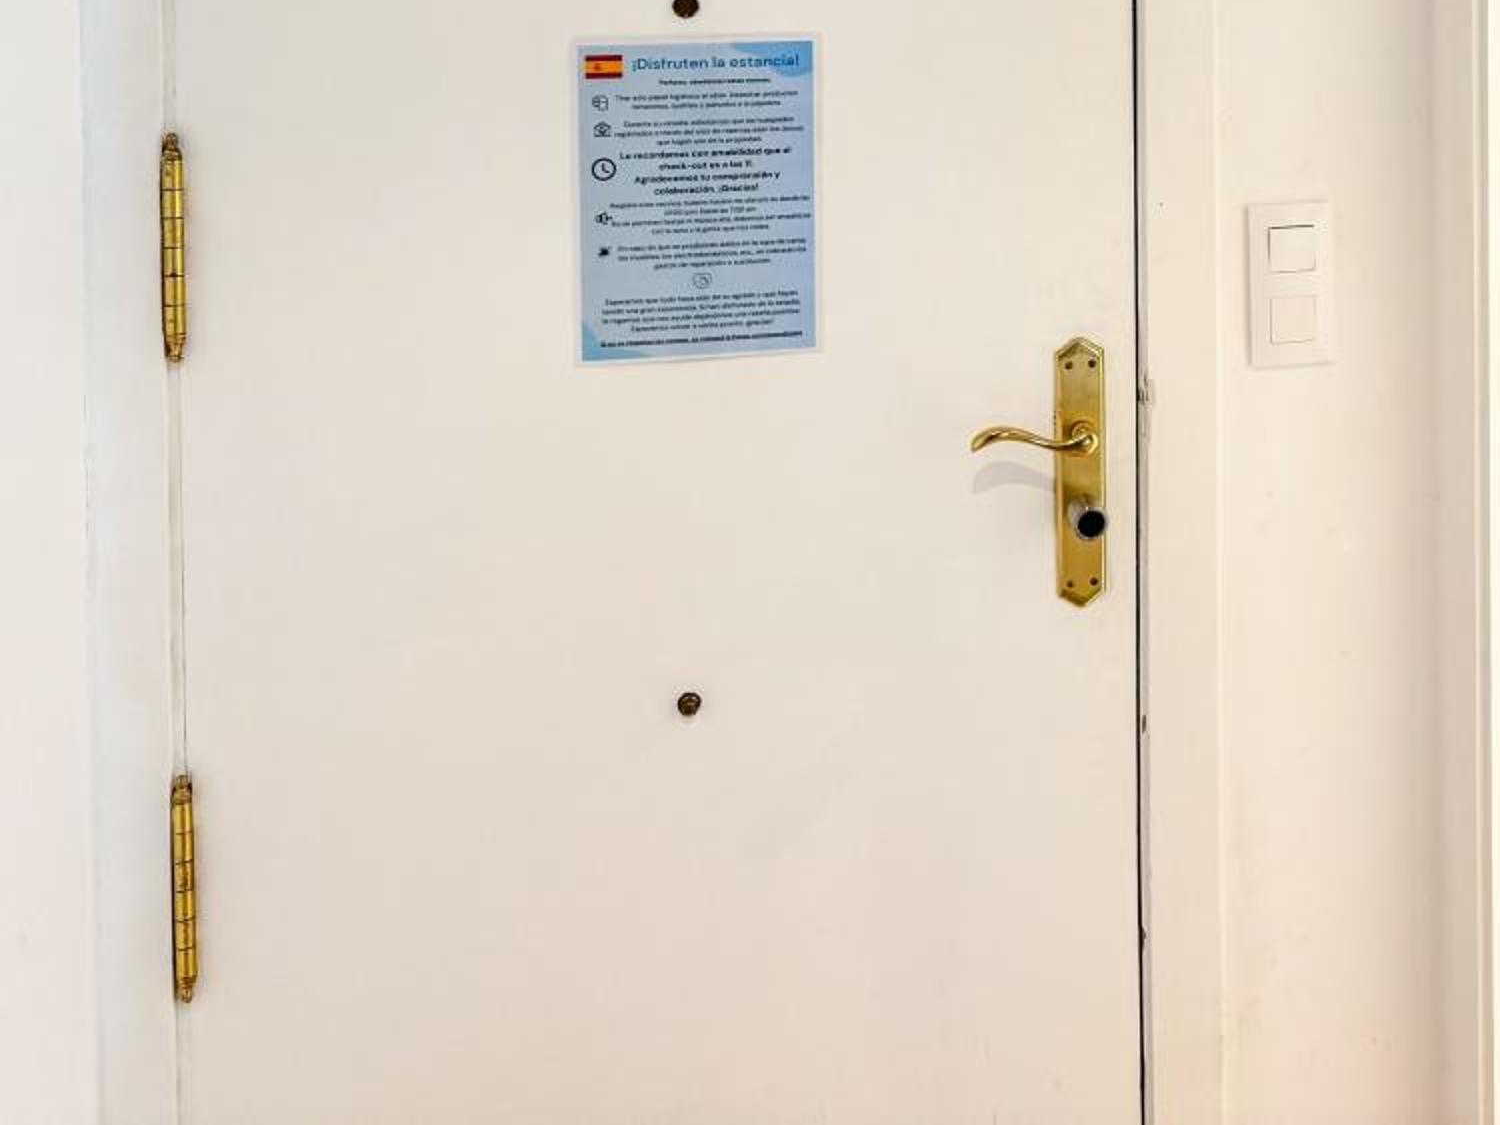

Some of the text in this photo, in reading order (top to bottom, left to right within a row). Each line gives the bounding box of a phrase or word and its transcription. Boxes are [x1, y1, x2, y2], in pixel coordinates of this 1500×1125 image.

[632, 53, 799, 72] ¡Disfruten la estancia!
